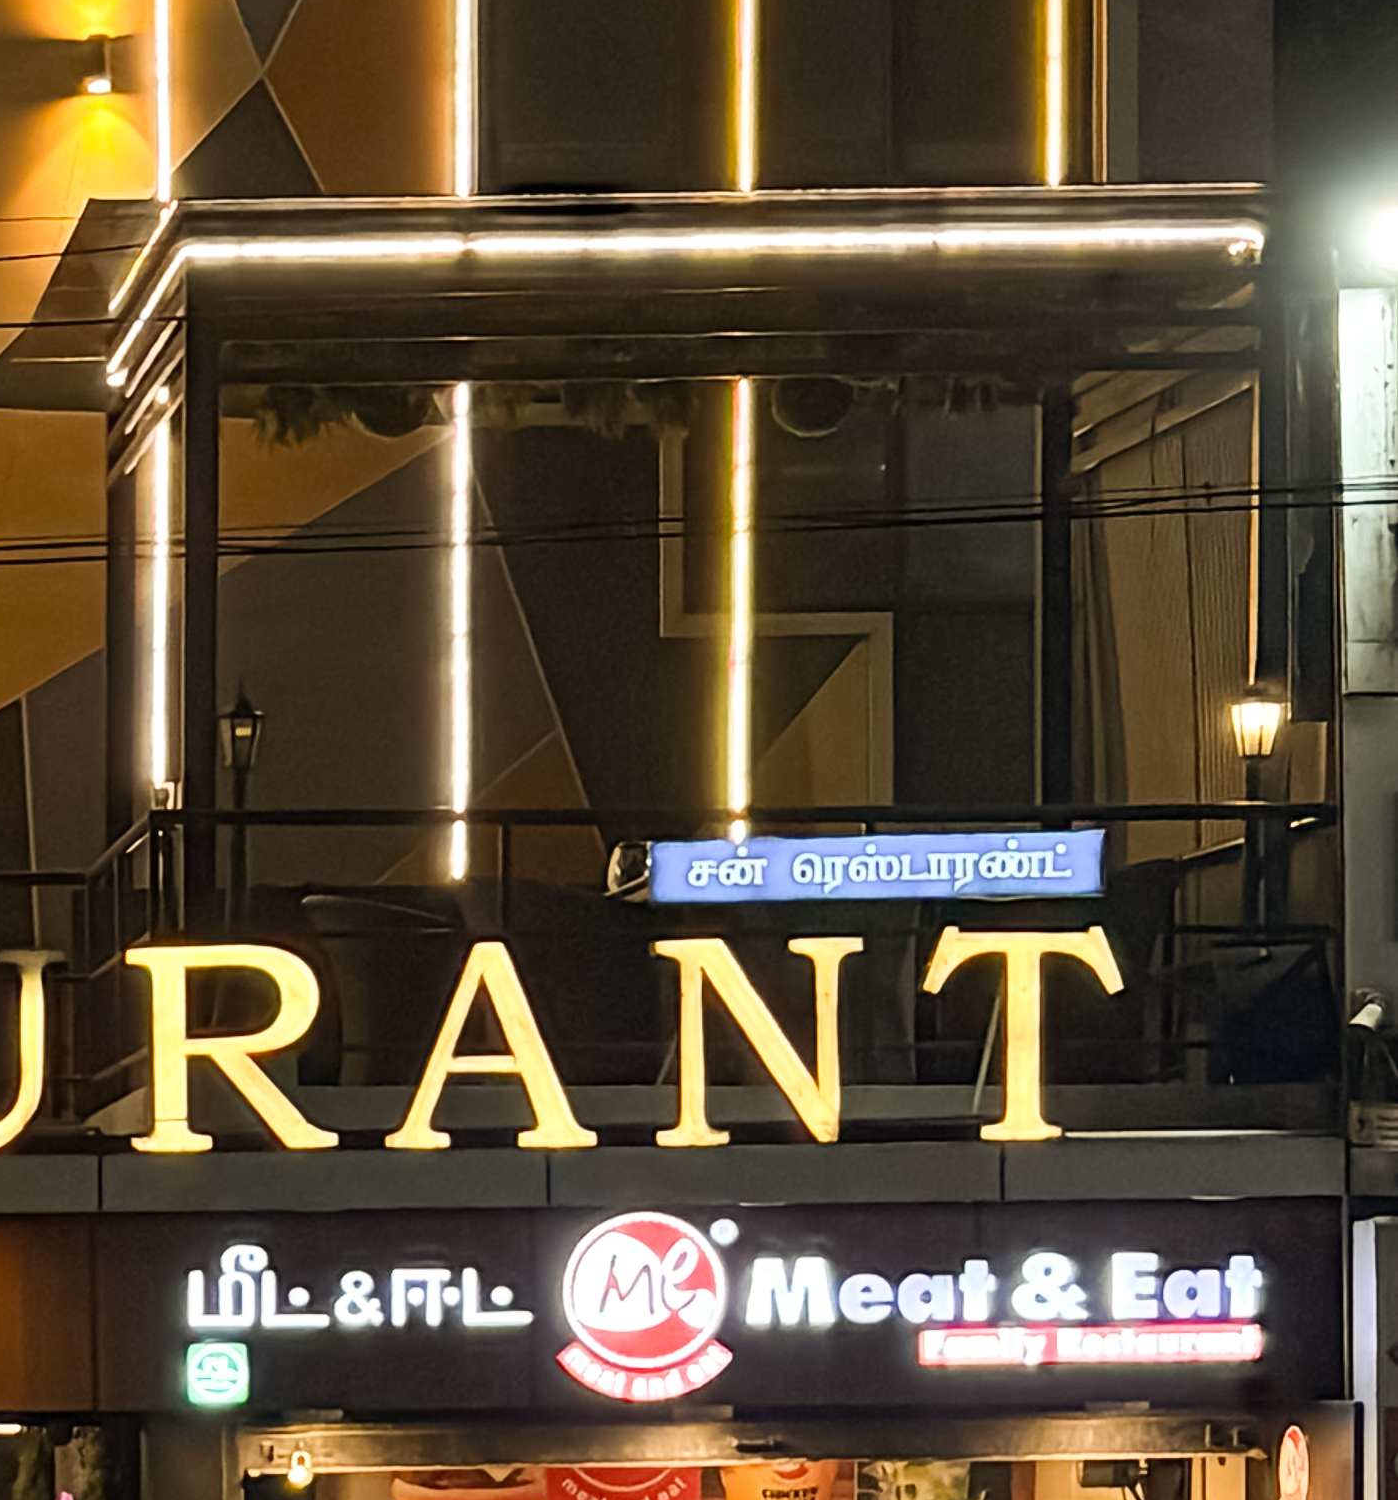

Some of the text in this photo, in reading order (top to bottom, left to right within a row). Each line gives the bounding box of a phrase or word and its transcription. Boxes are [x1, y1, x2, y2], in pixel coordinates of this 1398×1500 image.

[687, 845, 768, 887] சன்
[745, 1252, 1263, 1324] Meat & Eat
[631, 1368, 683, 1397] and
